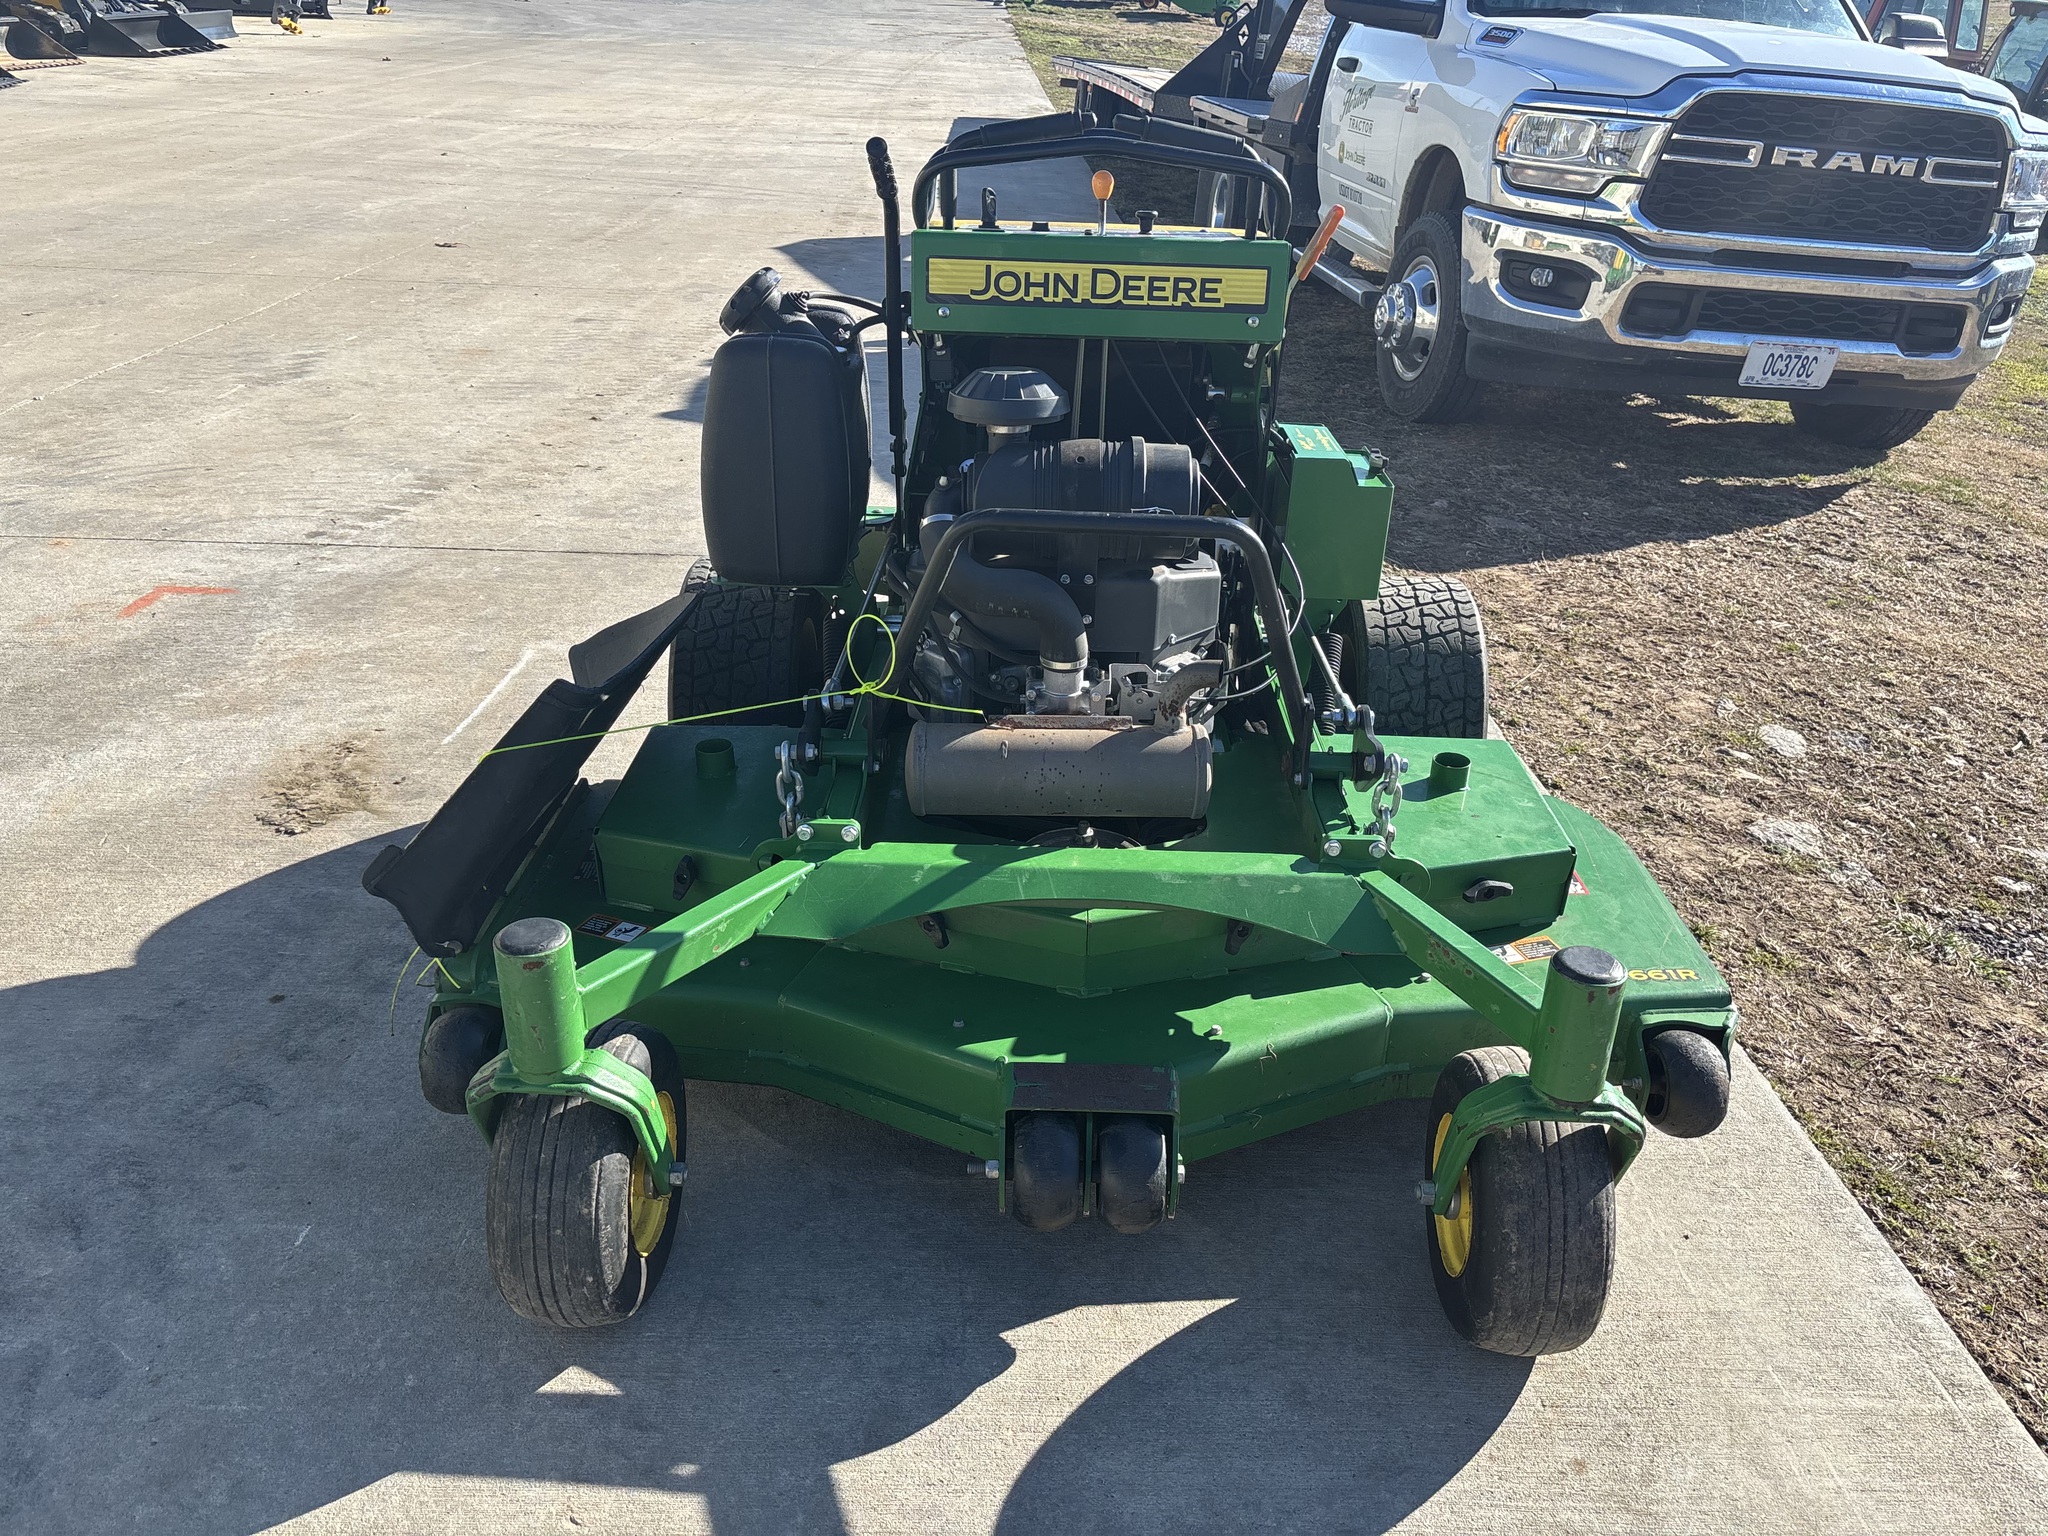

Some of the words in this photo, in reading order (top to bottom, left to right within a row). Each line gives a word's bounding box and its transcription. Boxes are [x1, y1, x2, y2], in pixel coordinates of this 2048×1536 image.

[1488, 29, 1514, 38] 3500
[1339, 83, 1376, 122] Heritage
[1349, 118, 1374, 134] TRACTOR
[1345, 148, 1354, 162] JOHN
[1354, 151, 1366, 166] DEERE
[1770, 145, 1920, 178] RAM
[968, 264, 1079, 299] JOHN
[1090, 268, 1224, 304] DEERE
[1628, 968, 1699, 981] 661R
